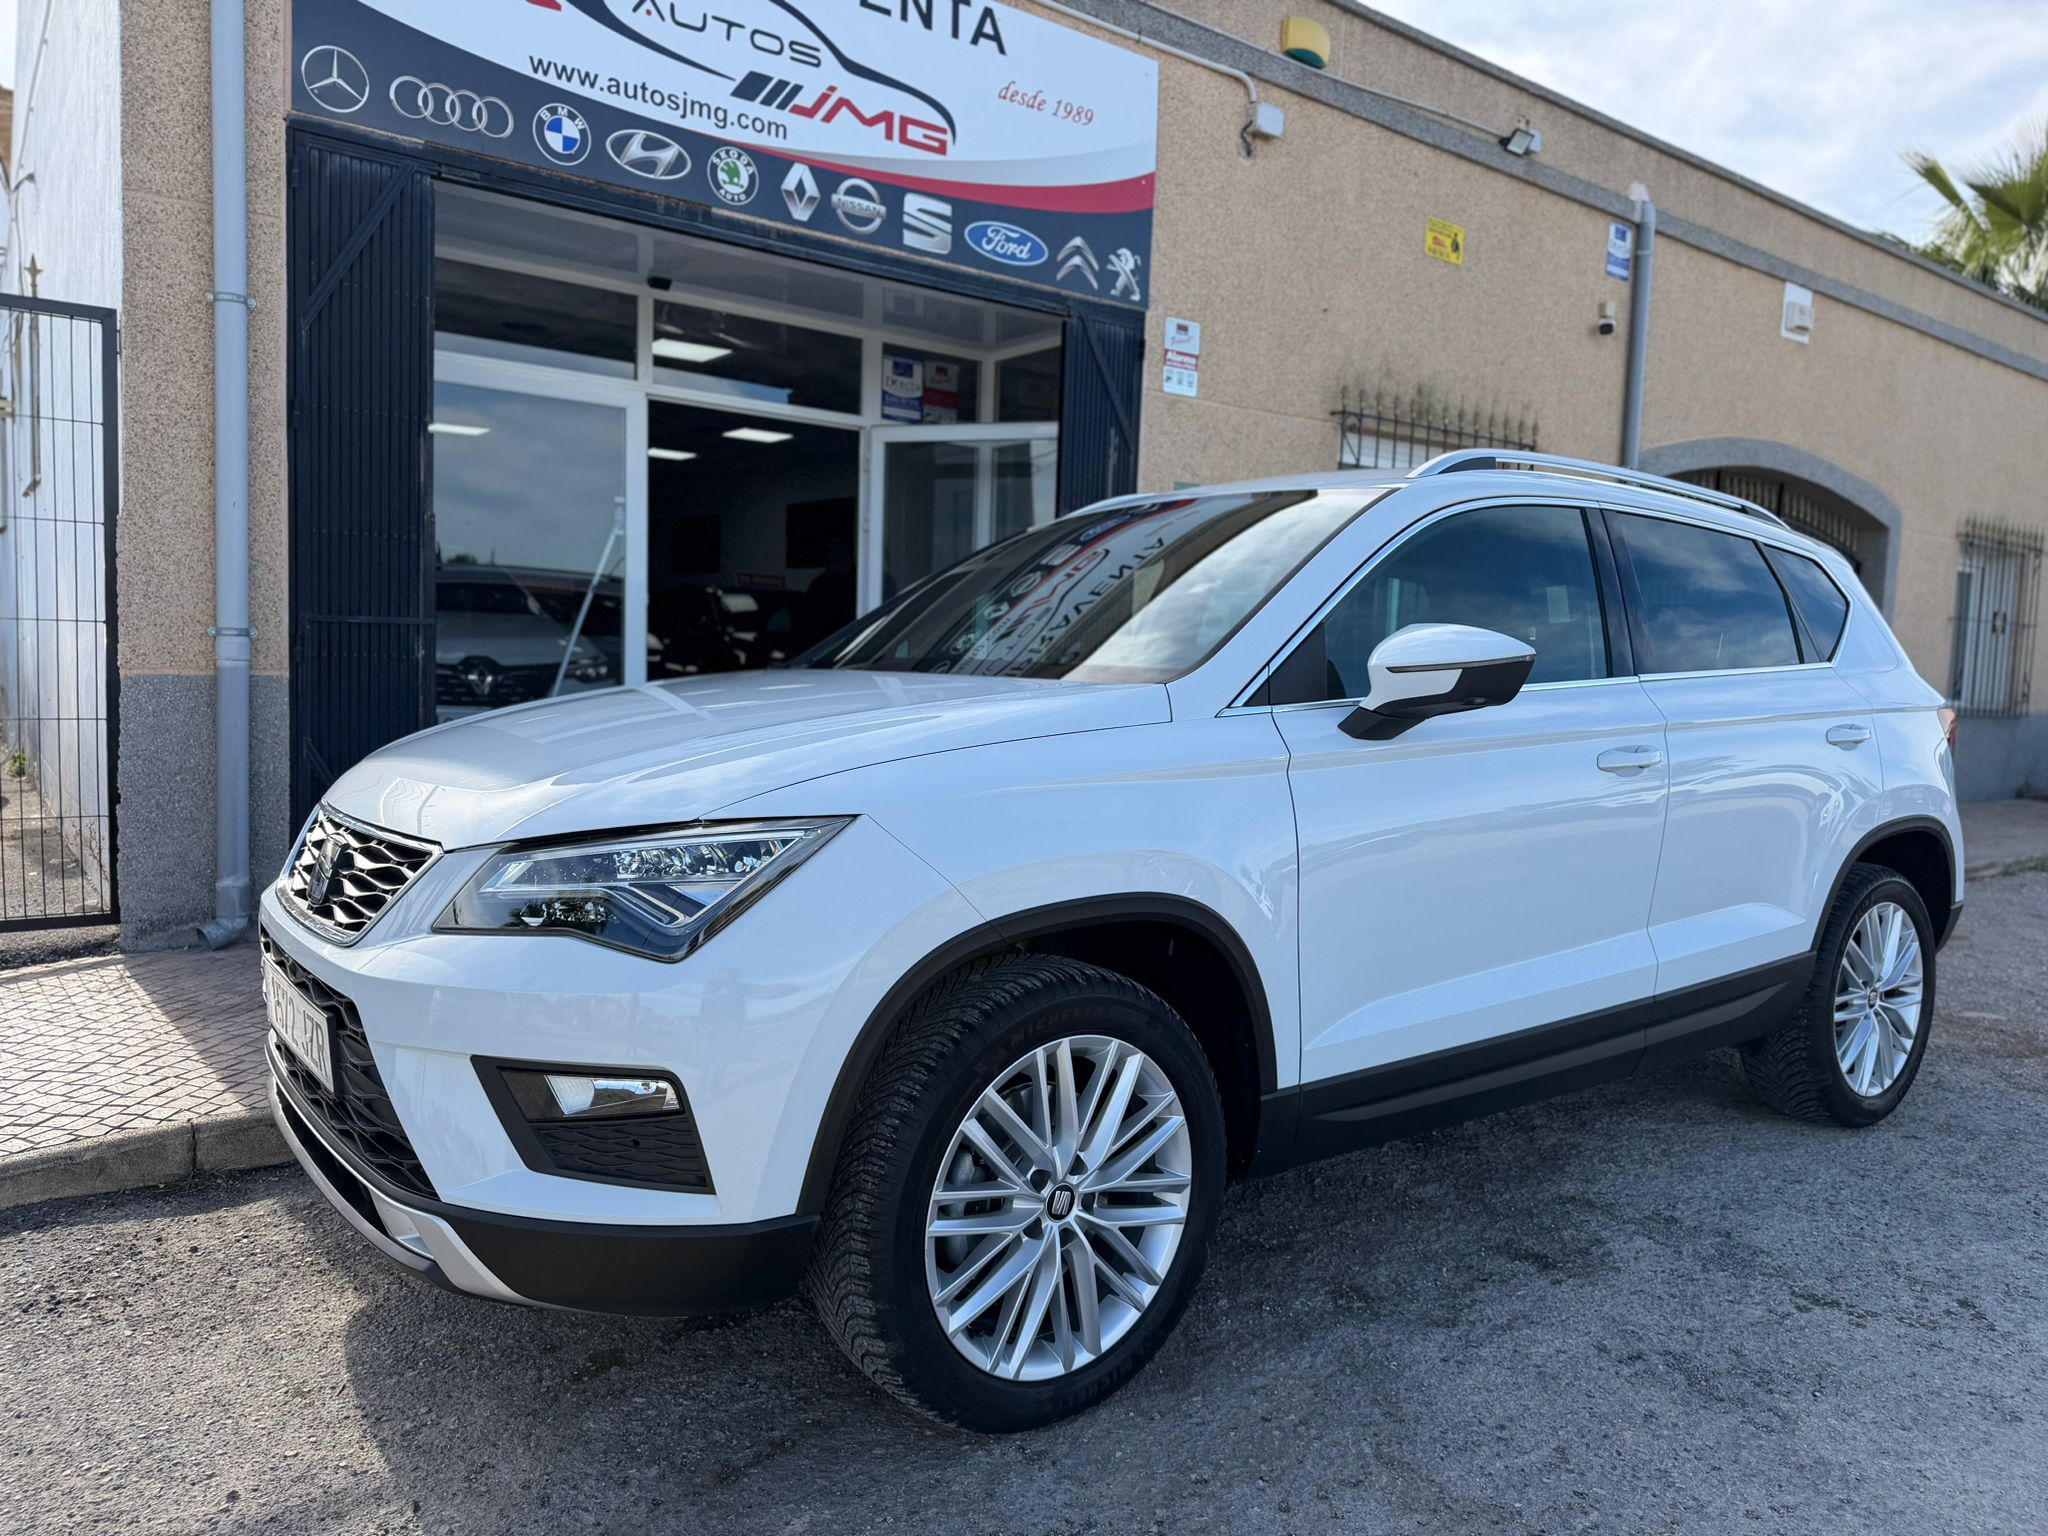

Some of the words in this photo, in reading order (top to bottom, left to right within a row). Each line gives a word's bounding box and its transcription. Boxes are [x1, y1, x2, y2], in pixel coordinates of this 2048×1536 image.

[632, 0, 822, 68] AUTOS
[859, 0, 1007, 56] NTA
[528, 55, 788, 141] www.autosjmg.com
[539, 105, 586, 131] BMW
[997, 80, 1047, 112] desde
[1051, 99, 1095, 126] 1989
[718, 188, 747, 202] AUTO
[836, 197, 883, 217] NISSAN
[981, 225, 1033, 260] Ford
